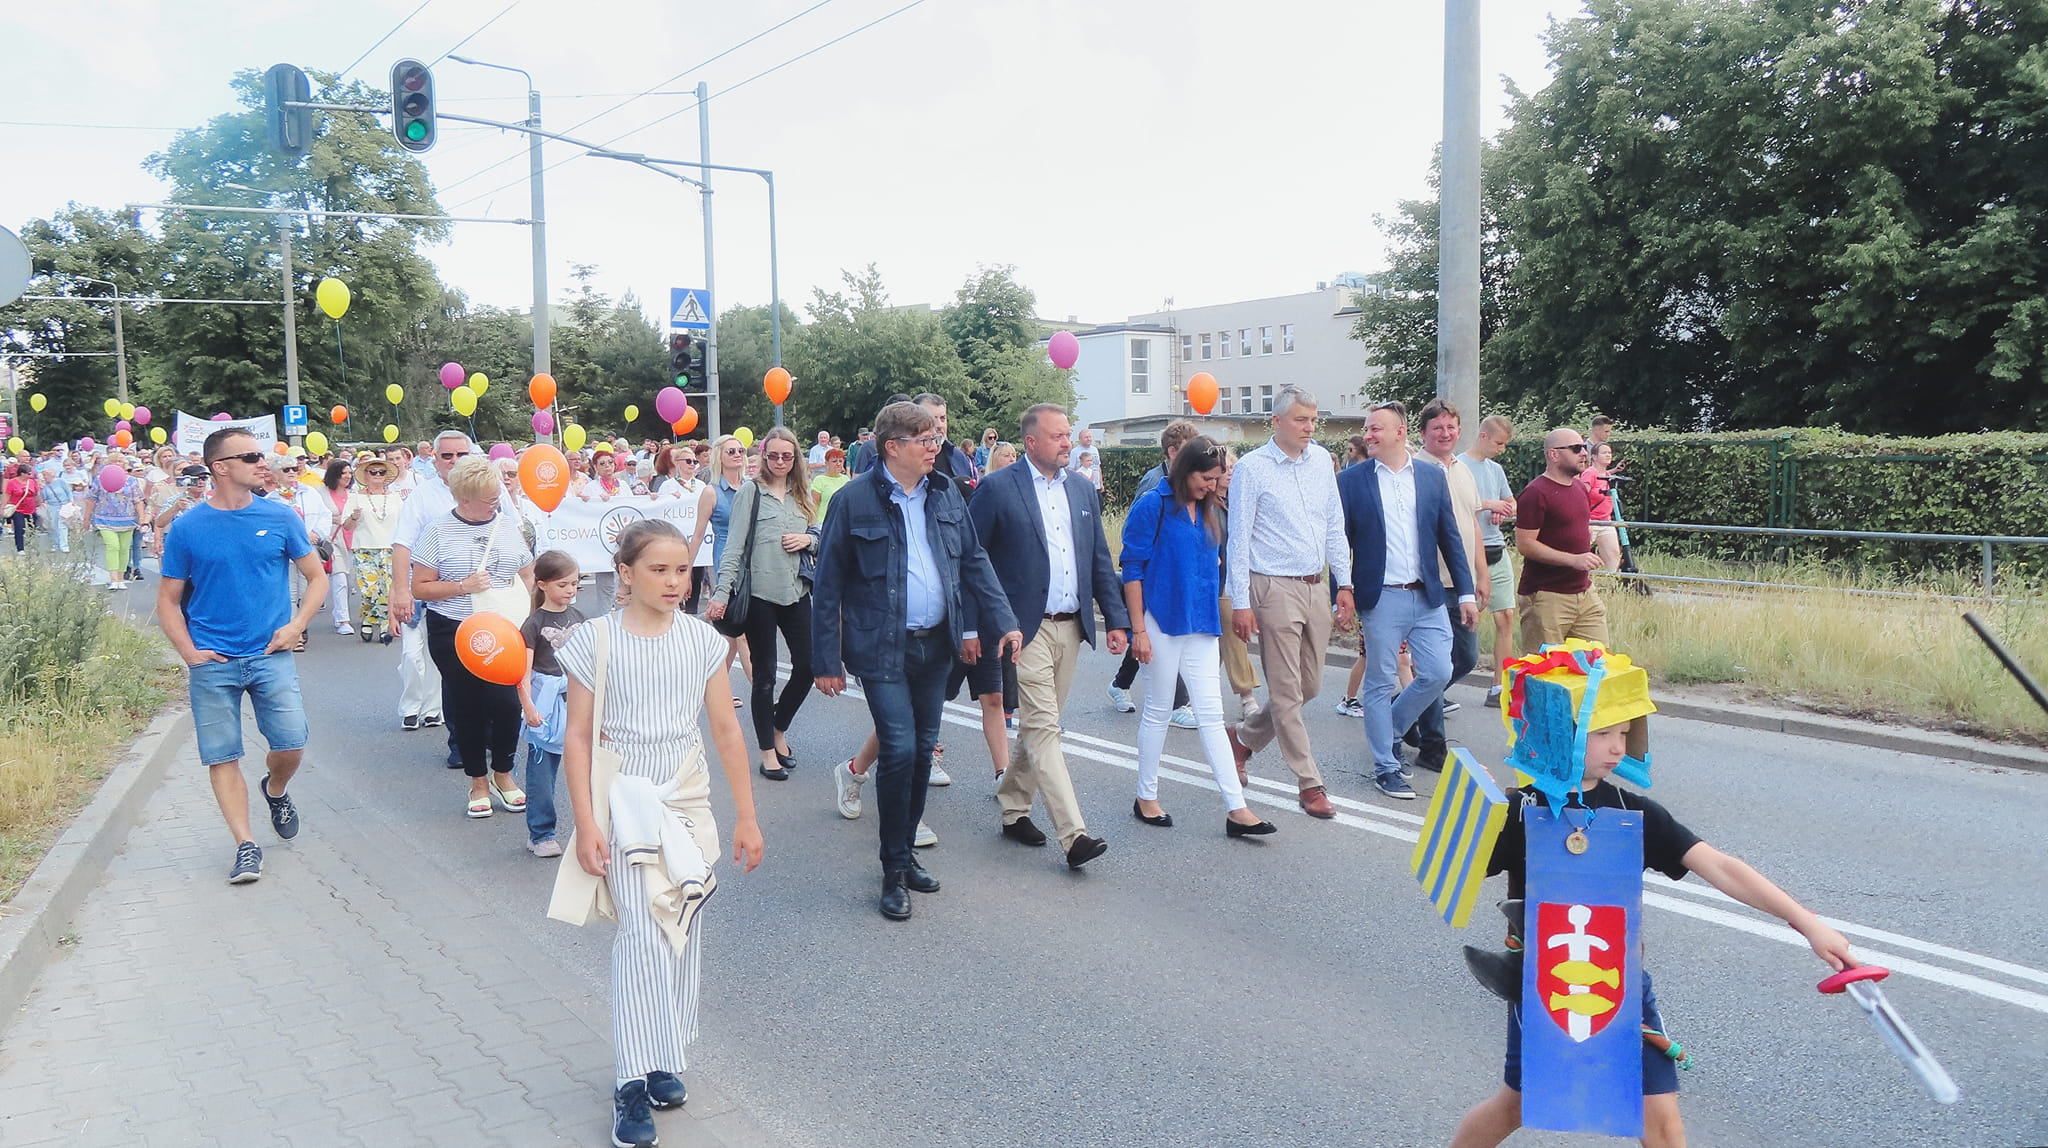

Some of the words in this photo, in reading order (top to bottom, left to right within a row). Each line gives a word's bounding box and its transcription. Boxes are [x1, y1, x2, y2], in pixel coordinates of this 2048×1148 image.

[289, 407, 302, 423] P
[663, 506, 695, 519] KLUB
[546, 527, 599, 541] CISOWA
